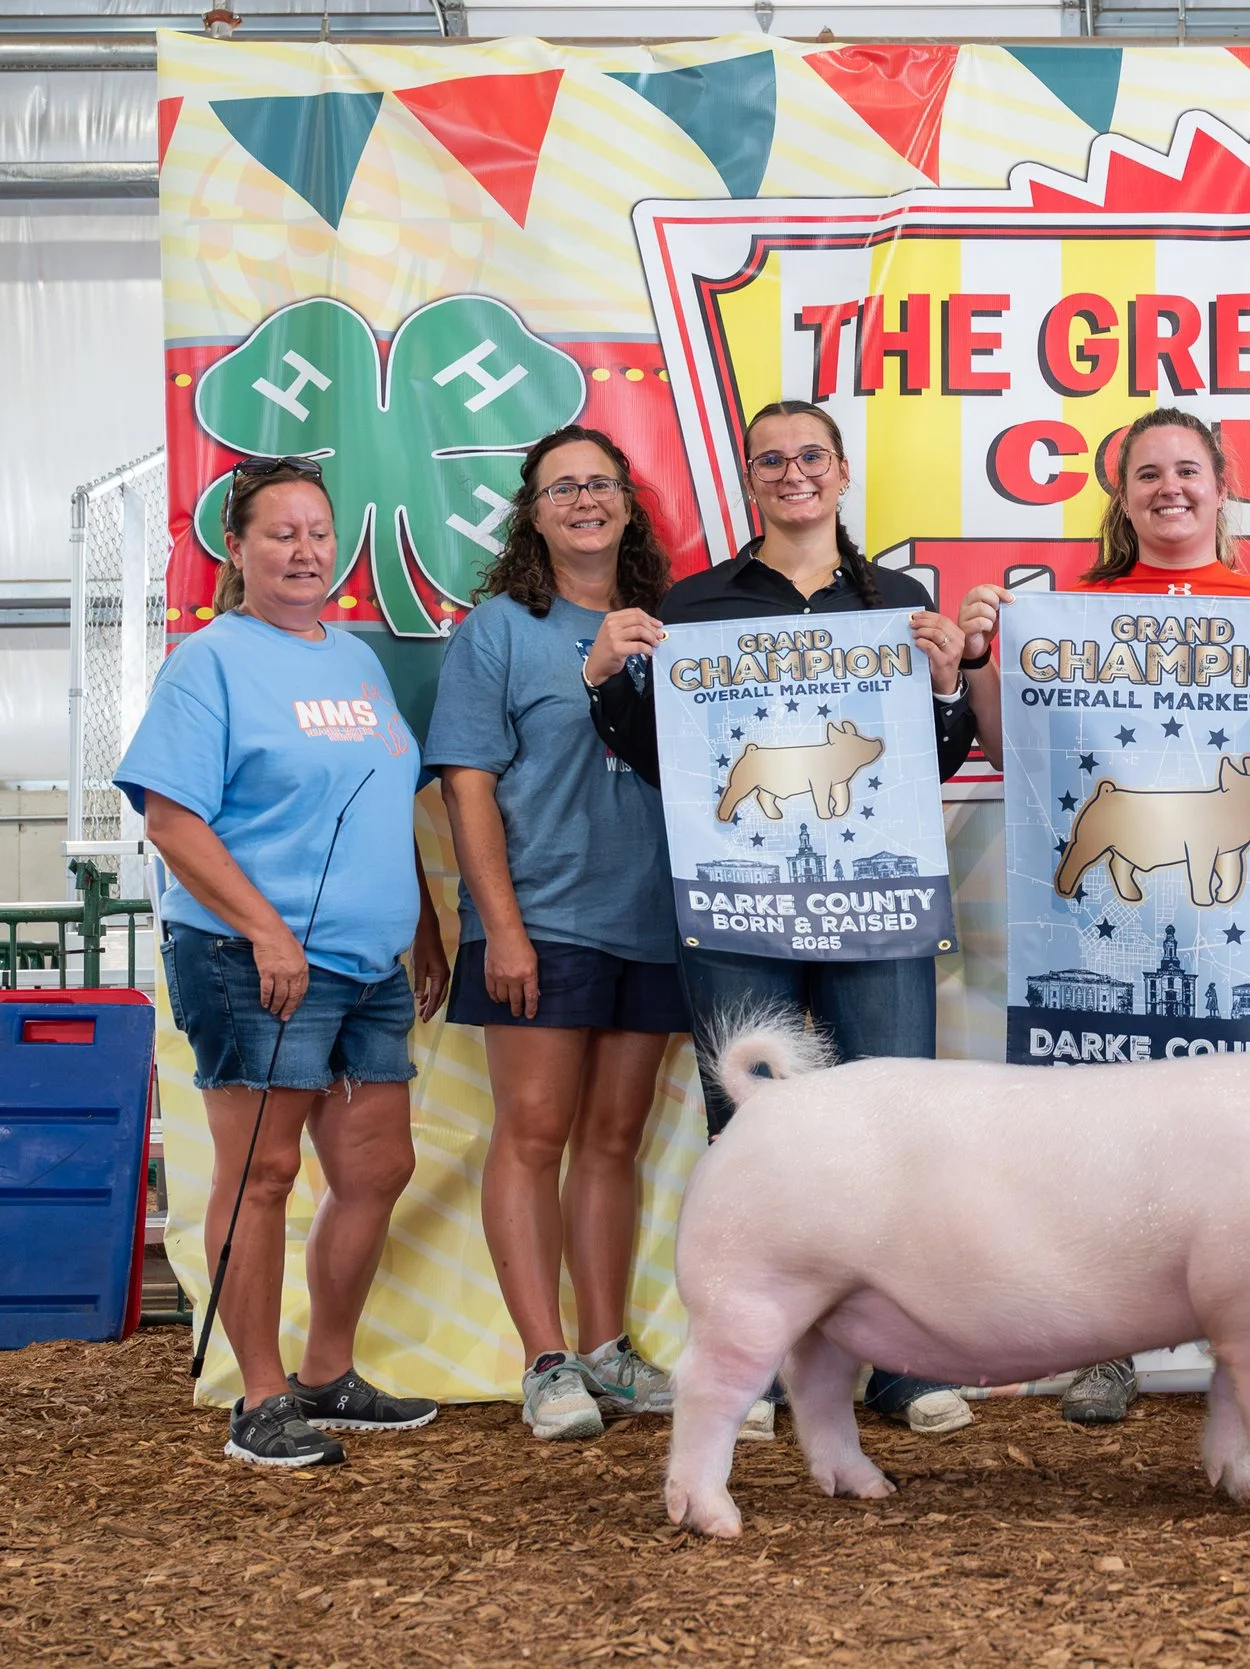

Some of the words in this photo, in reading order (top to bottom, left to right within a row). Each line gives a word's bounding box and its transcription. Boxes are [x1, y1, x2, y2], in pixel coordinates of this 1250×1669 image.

[794, 293, 1011, 404] THE
[738, 629, 832, 653] GRAND
[1112, 614, 1235, 645] GRAND
[670, 643, 912, 691] CHAMPION
[693, 685, 773, 704] OVERALL
[780, 682, 851, 697] MARKET
[857, 680, 892, 693] GILT
[1021, 687, 1143, 710] OVERALL
[293, 698, 378, 730] NMS
[688, 889, 796, 916] DARKE
[806, 888, 936, 915] COUNTY
[712, 913, 785, 932] BORN
[794, 917, 812, 933] &
[822, 913, 917, 932] RAISED
[791, 935, 842, 950] 2025
[1029, 1027, 1152, 1063] DARKE
